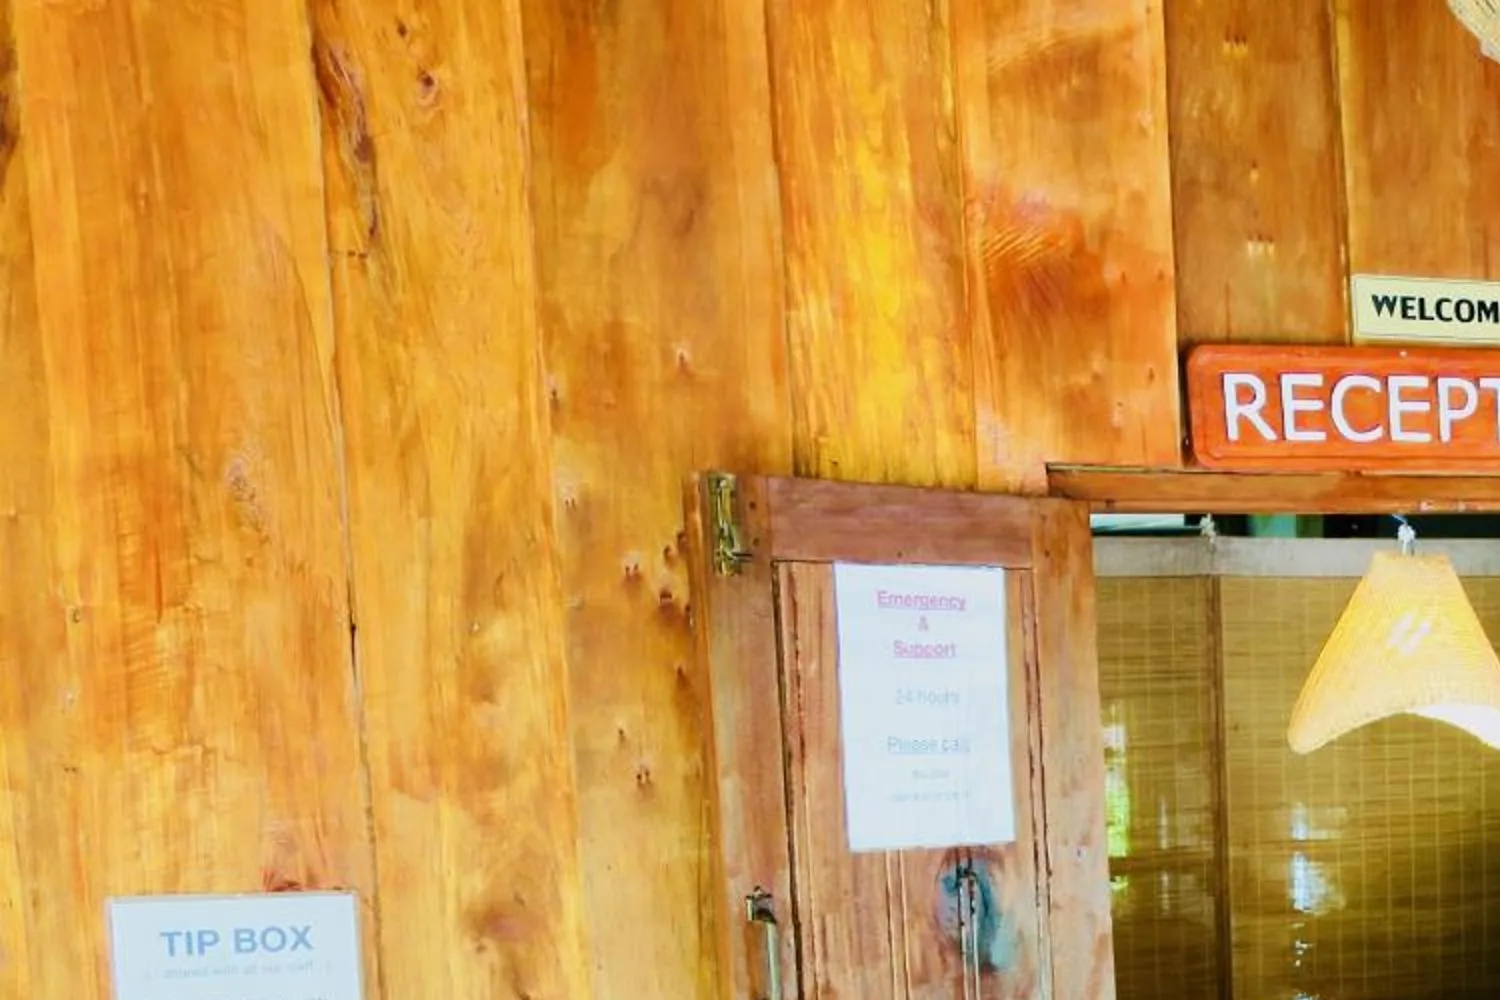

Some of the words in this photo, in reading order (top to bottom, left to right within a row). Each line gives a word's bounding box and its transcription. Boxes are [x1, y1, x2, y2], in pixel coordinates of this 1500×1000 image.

[877, 589, 967, 613] Emergency
[892, 639, 957, 660] Support
[159, 929, 221, 957] TIP
[233, 925, 314, 954] BOX
